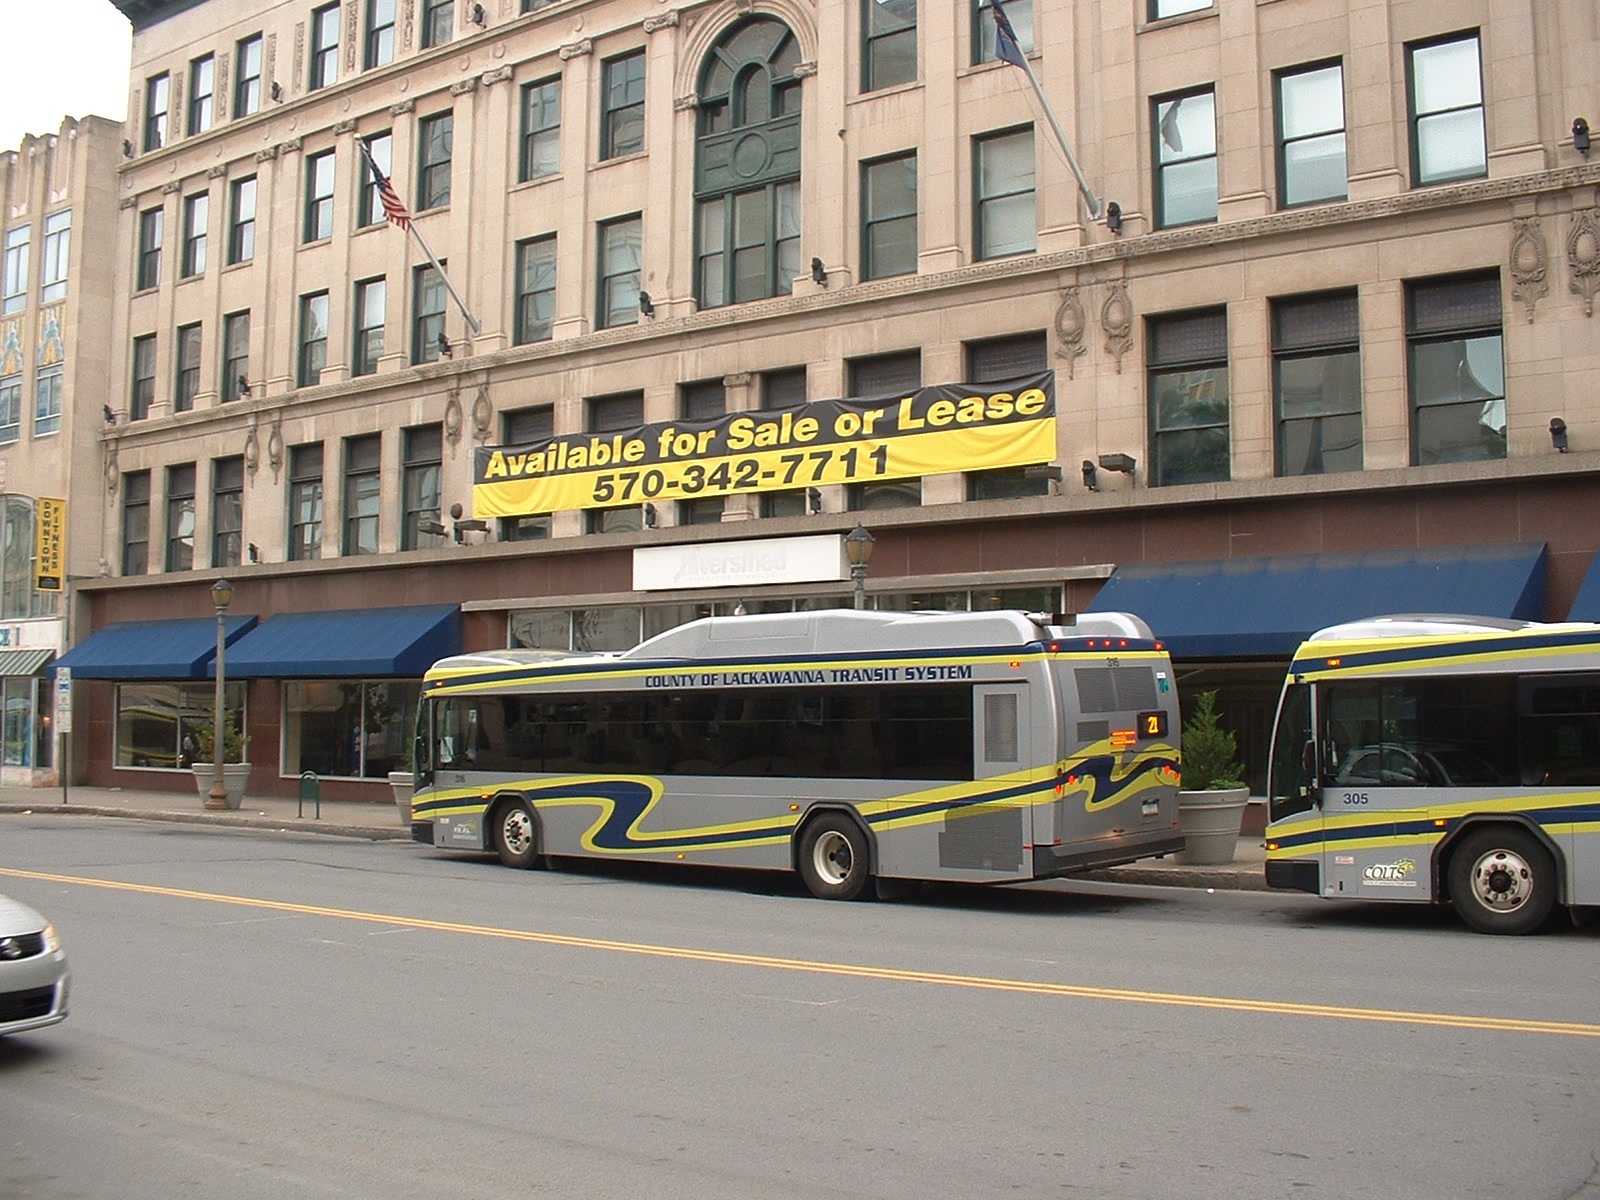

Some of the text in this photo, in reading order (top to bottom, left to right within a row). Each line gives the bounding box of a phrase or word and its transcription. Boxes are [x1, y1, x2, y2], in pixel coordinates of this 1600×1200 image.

[484, 388, 1046, 479] Available for Sale or Lease
[592, 444, 888, 502] 570-342-7711
[41, 501, 51, 573] DOWNTOWN
[52, 506, 60, 569] FITNESS
[645, 665, 972, 688] COUNTY OF LACKAWANNA TRANSIT SYSTEM
[1343, 793, 1369, 805] 305
[1363, 865, 1406, 880] COLTS
